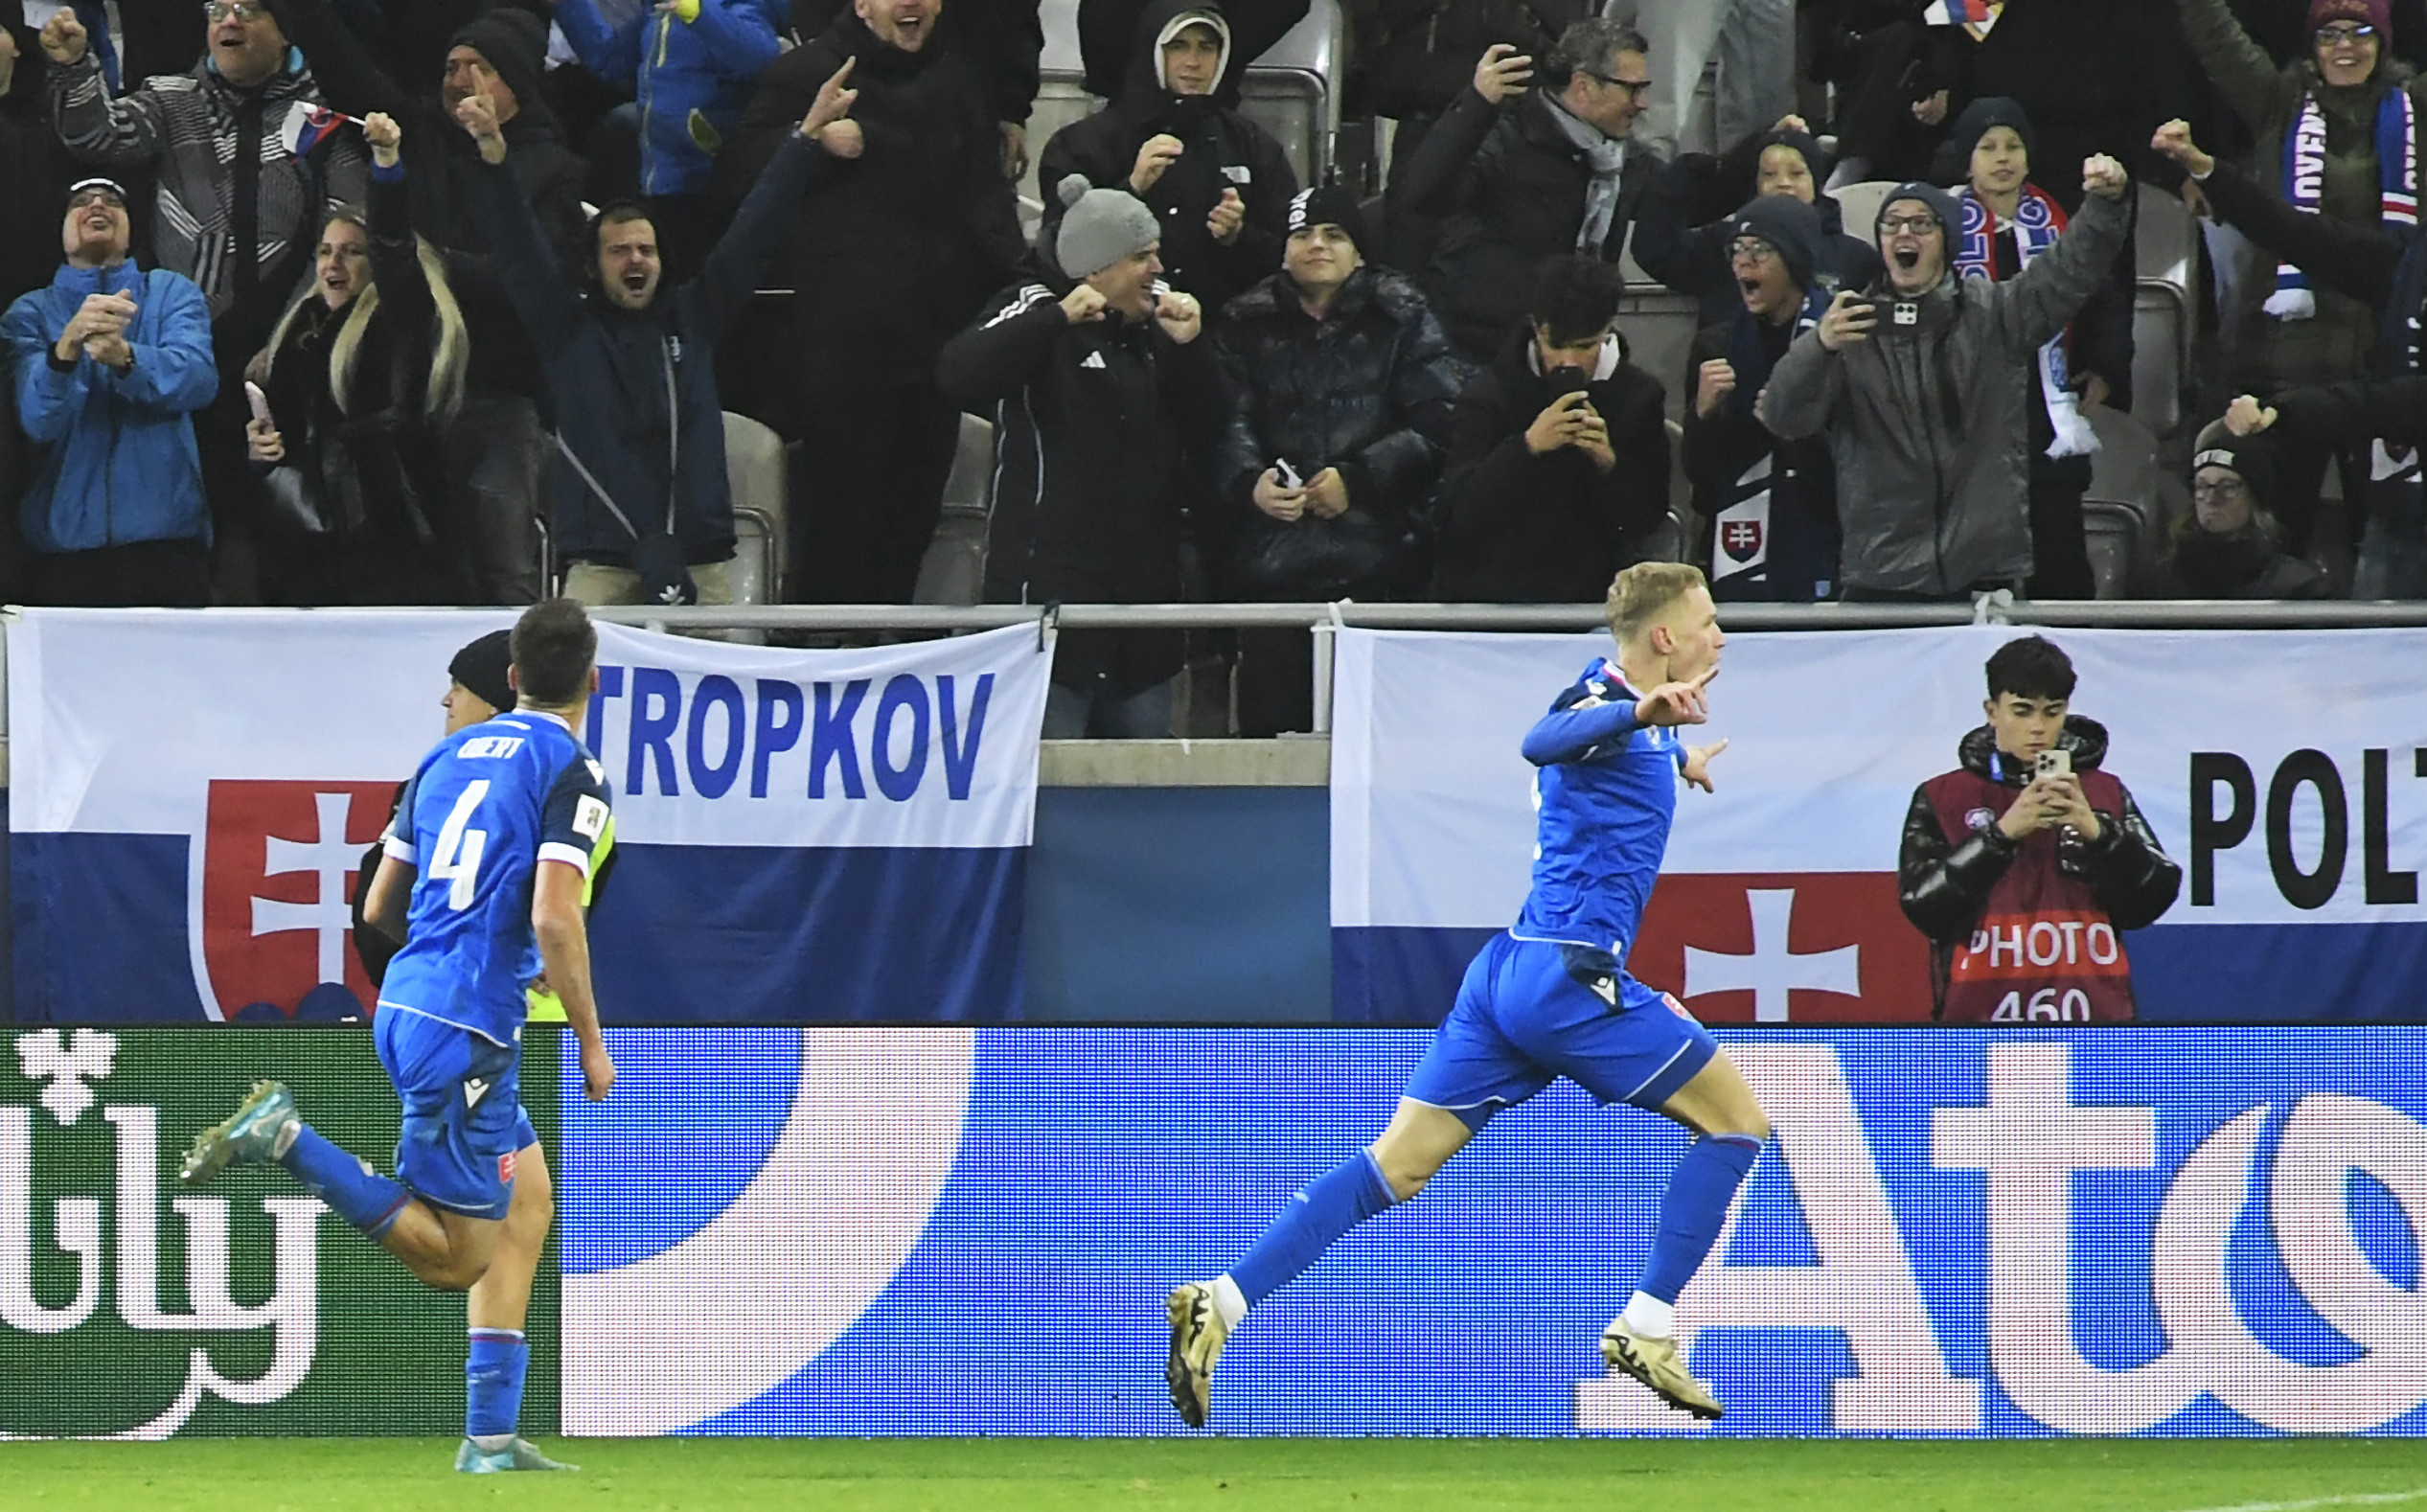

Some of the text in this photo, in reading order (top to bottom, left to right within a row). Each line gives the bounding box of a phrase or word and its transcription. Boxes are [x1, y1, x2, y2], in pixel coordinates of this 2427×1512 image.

[585, 665, 996, 802] TROPKOV
[427, 779, 492, 912] 4
[1961, 922, 2118, 970] PHOTO
[1991, 988, 2091, 1021] 460
